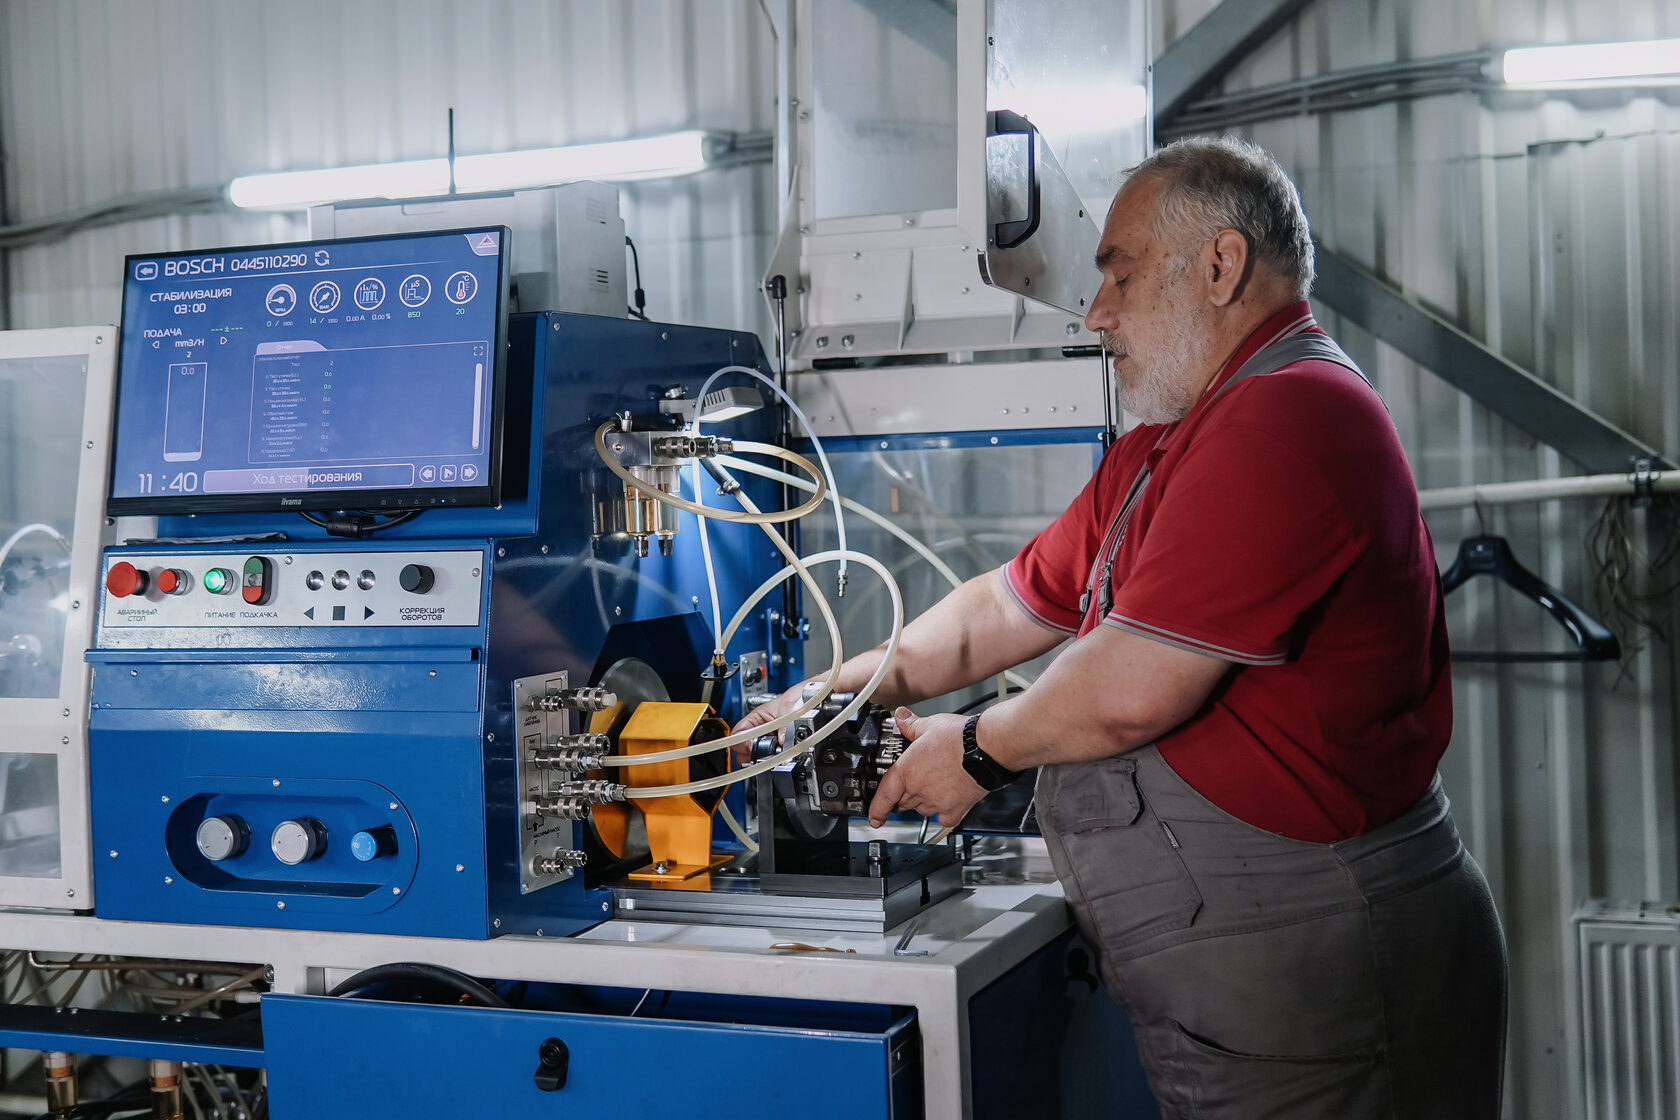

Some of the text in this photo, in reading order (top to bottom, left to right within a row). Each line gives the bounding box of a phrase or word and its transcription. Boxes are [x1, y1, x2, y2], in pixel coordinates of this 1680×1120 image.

[164, 253, 308, 277] BOSCH 0445110290
[150, 287, 232, 302] СТАБИЛИЗАЦИЯ
[173, 303, 207, 315] 03:00
[455, 308, 466, 316] 20
[407, 311, 421, 319] 850
[143, 327, 183, 338] ПОДАЧА
[186, 350, 192, 358] 2
[181, 366, 195, 376] 0.0
[252, 471, 362, 486] Ход тестирования
[204, 611, 279, 619] ПИТАНИЕ ПОДКАЧКА
